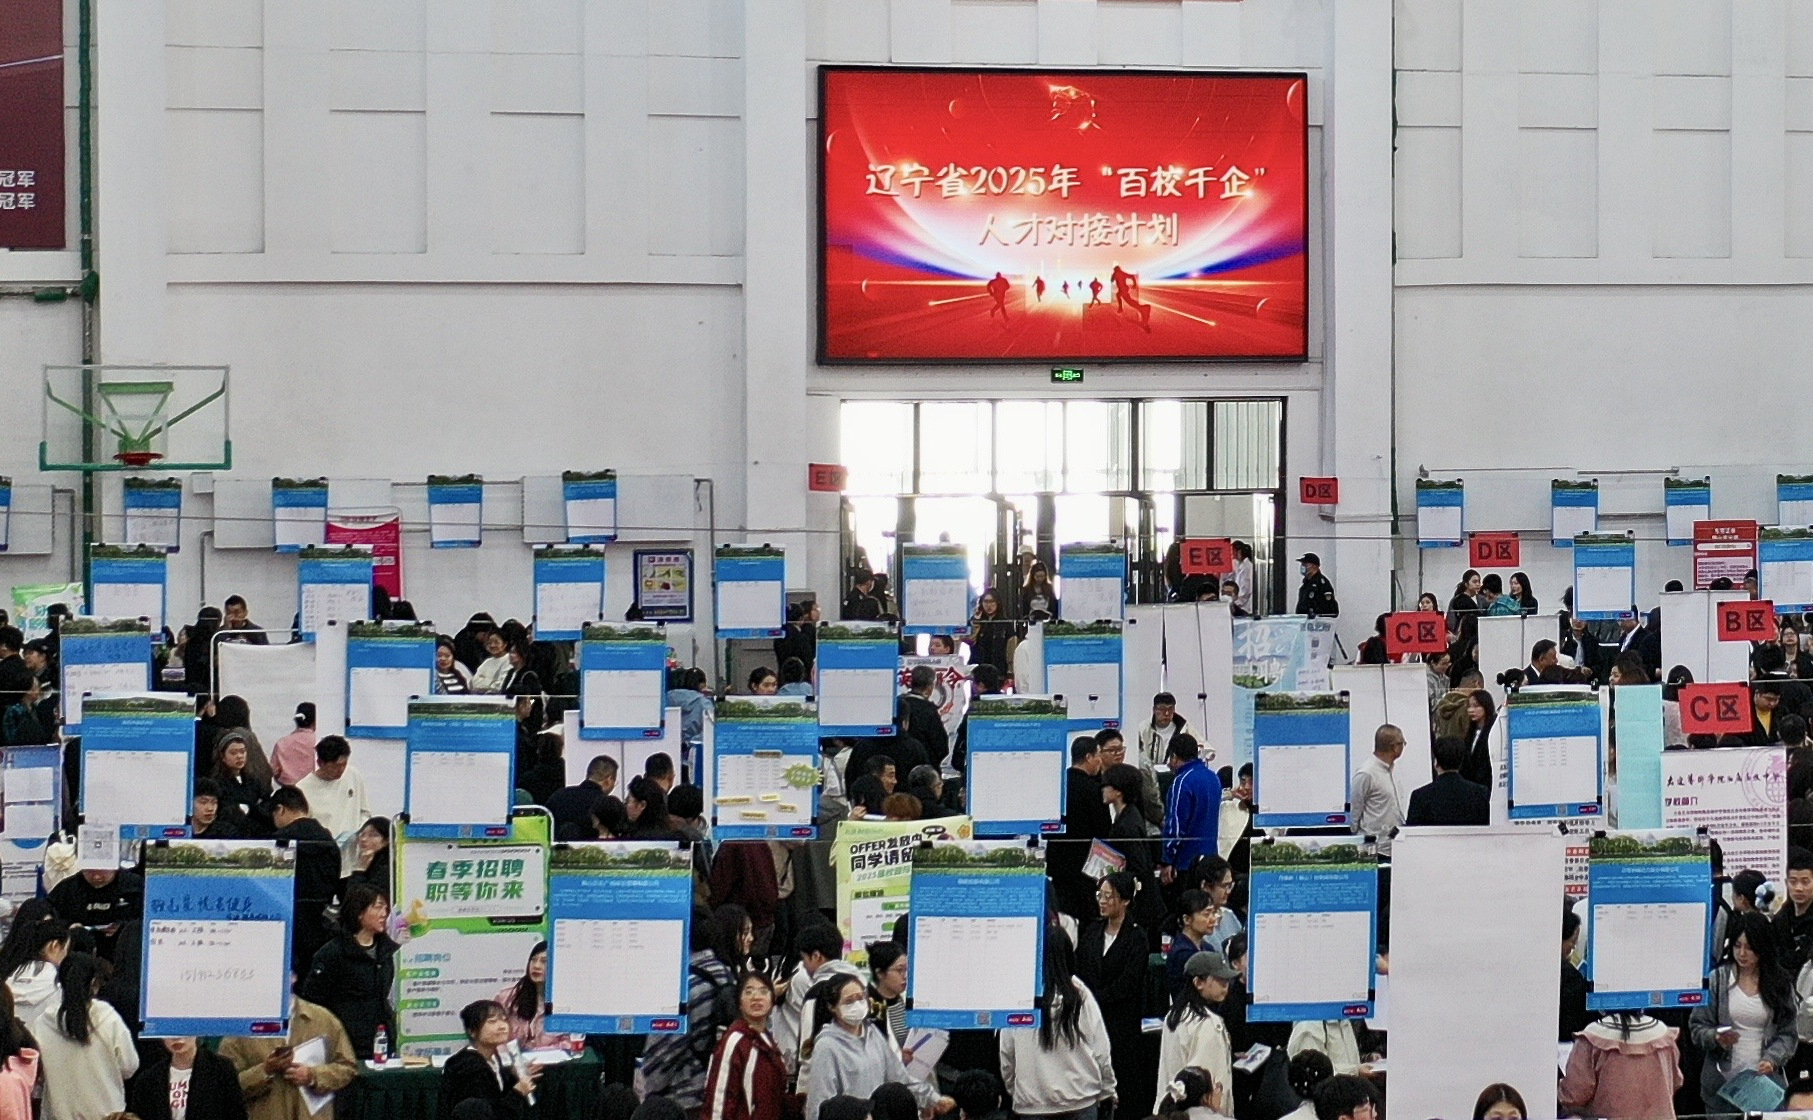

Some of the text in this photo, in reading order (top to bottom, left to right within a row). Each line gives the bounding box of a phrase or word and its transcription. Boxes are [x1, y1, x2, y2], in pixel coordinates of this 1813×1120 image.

[865, 163, 1267, 199] 辽宁省2025年 “百校千企”
[979, 211, 1180, 247] 人才对接计划
[1305, 481, 1333, 498] D区
[1188, 546, 1225, 567] E区
[1477, 539, 1513, 560] D区
[1394, 619, 1438, 643] C区
[1726, 607, 1767, 632] B区
[1689, 693, 1741, 722] C区
[426, 859, 525, 880] 春季招聘
[425, 880, 525, 903] 职等你来
